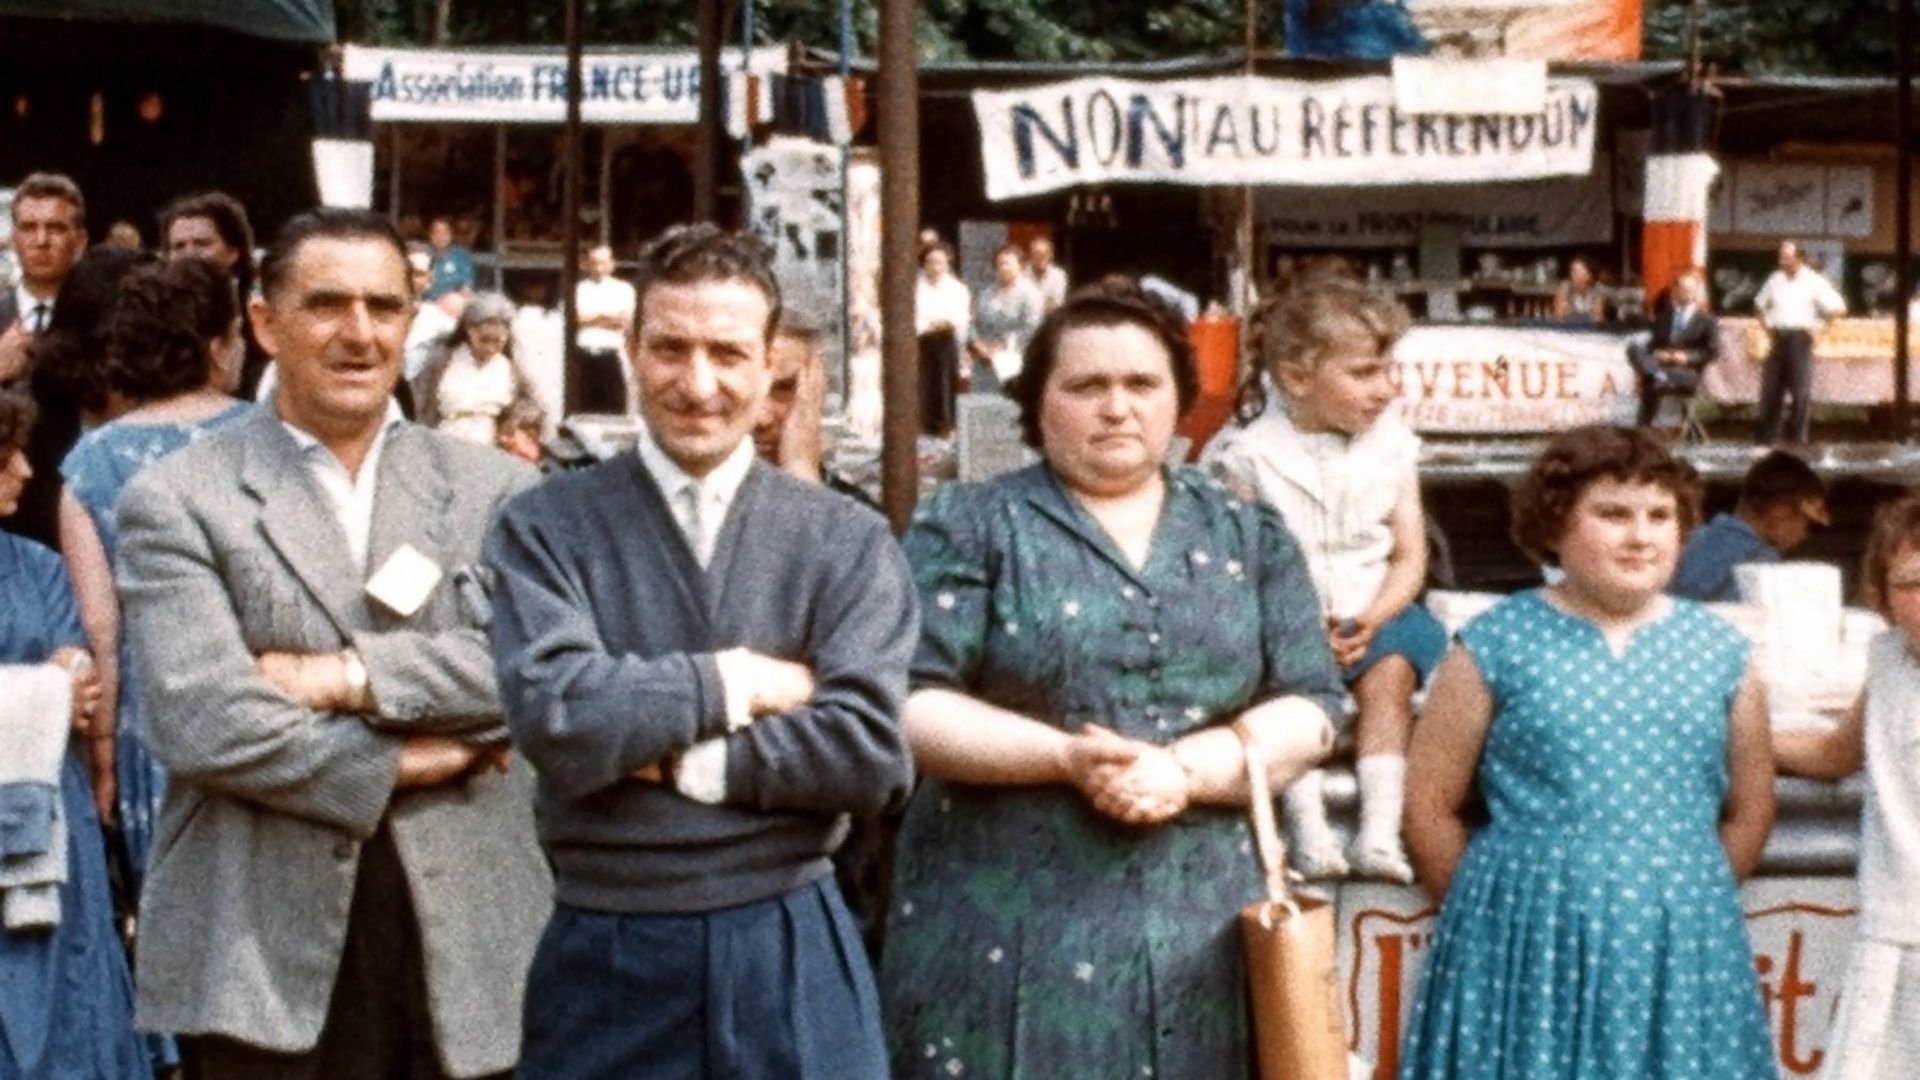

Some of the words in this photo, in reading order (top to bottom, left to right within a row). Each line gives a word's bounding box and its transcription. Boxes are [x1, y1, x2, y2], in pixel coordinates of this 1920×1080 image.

[376, 62, 525, 102] Association
[1012, 89, 1186, 178] NON
[1206, 104, 1280, 156] AU
